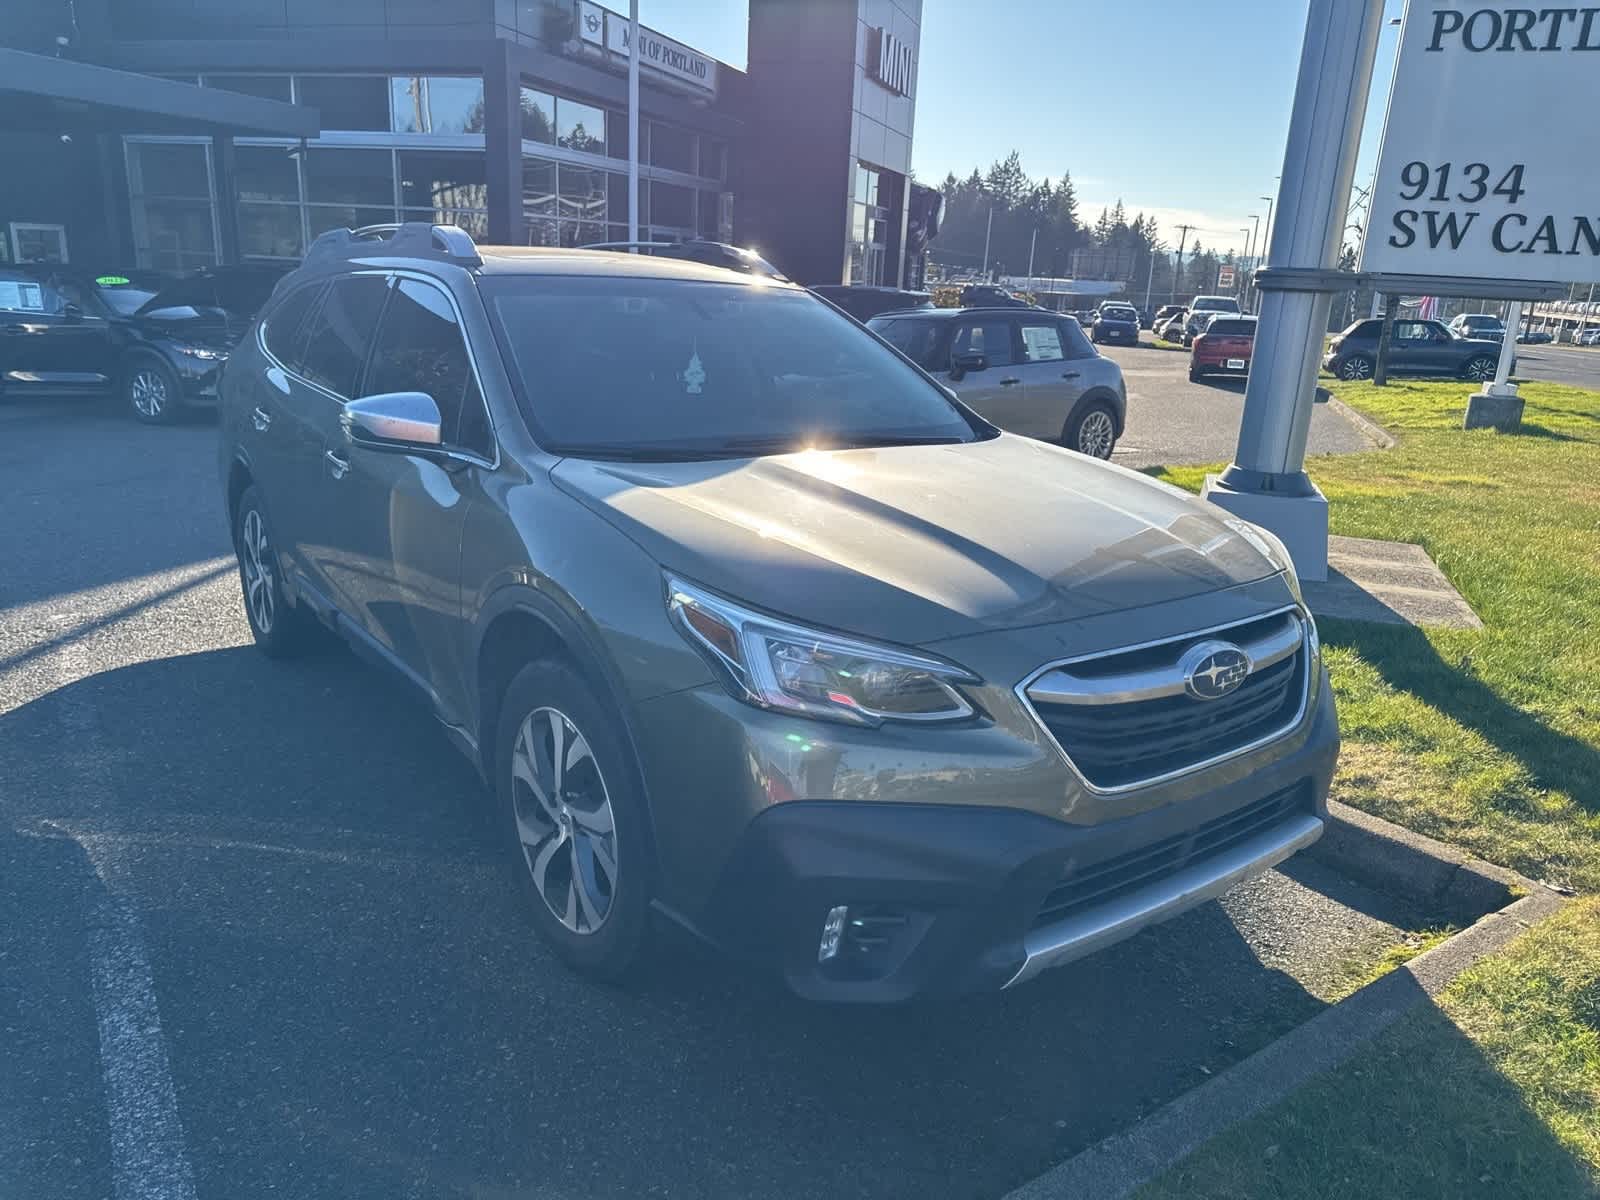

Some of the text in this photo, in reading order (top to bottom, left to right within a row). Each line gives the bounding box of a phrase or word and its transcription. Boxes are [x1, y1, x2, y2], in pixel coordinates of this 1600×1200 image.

[622, 29, 706, 79] MNI OF PORTLAND
[879, 28, 913, 97] MINI
[1399, 161, 1525, 204] 9134
[1388, 210, 1480, 250] SW
